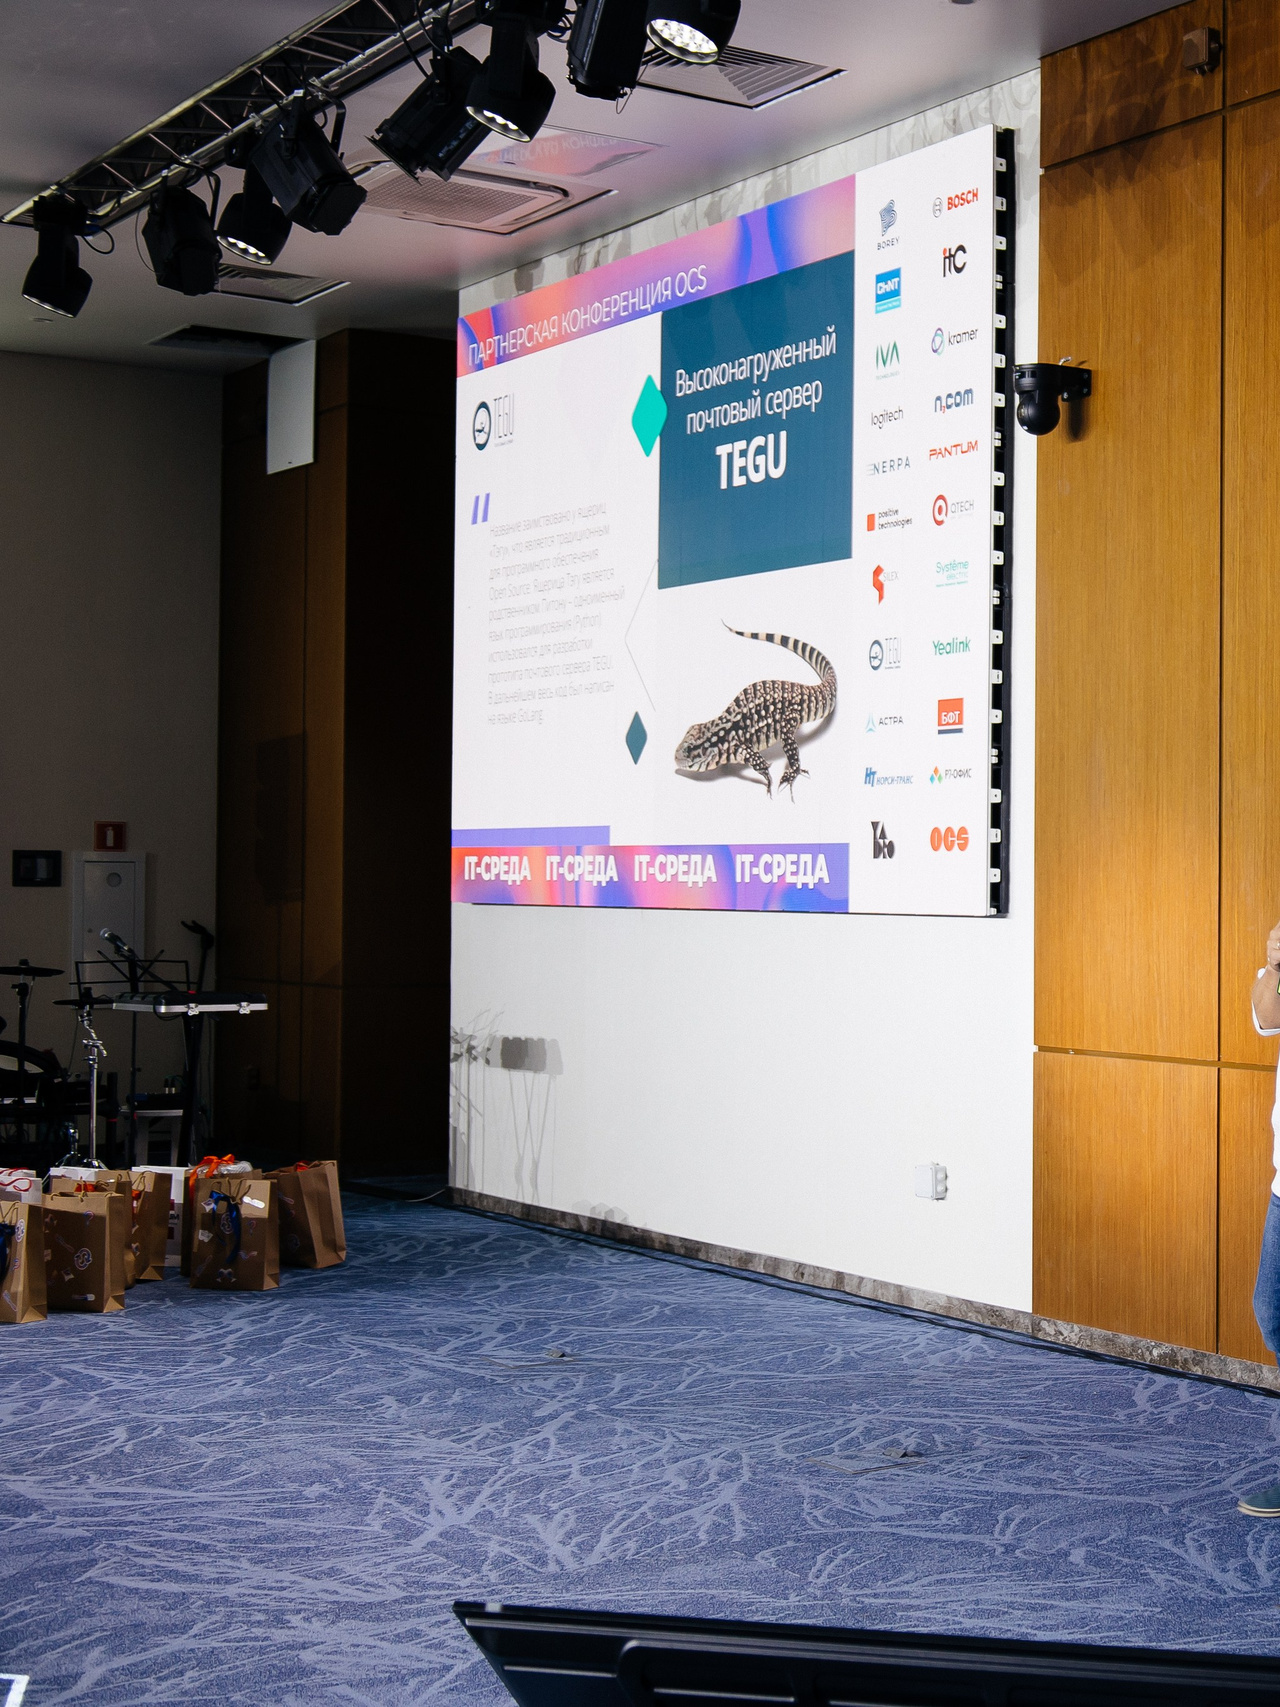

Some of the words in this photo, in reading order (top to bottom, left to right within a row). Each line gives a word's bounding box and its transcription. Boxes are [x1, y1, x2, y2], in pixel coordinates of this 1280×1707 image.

[947, 188, 979, 211] BOSCH
[877, 236, 900, 251] BOREY
[468, 316, 558, 366] ПАРТНЕРСКАЯ
[562, 276, 672, 334] КОНФЕРЕНЦИЯ
[674, 264, 708, 298] OCS
[948, 328, 979, 346] kramer
[675, 324, 837, 397] Высоконагруженный
[876, 341, 900, 370] IVA
[493, 393, 515, 440] TEGU
[686, 389, 762, 435] почтовый
[764, 380, 823, 420] сервер
[871, 406, 904, 430] logitech
[715, 430, 788, 490] TEGU
[929, 440, 979, 461] PANTUM
[867, 456, 911, 476] NERPA
[878, 507, 899, 519] positive
[951, 499, 975, 515] QTECH
[878, 516, 913, 530] technologies
[933, 637, 971, 655] Yealink
[878, 716, 904, 726] АСТРА
[941, 711, 961, 724] БФТ
[930, 826, 969, 852] OCS
[464, 855, 531, 886] IT-СРЕДА
[546, 854, 618, 887] IT-СРЕДА
[634, 853, 717, 888] IT-СРЕДА
[735, 853, 830, 890] IT-СРЕДА
